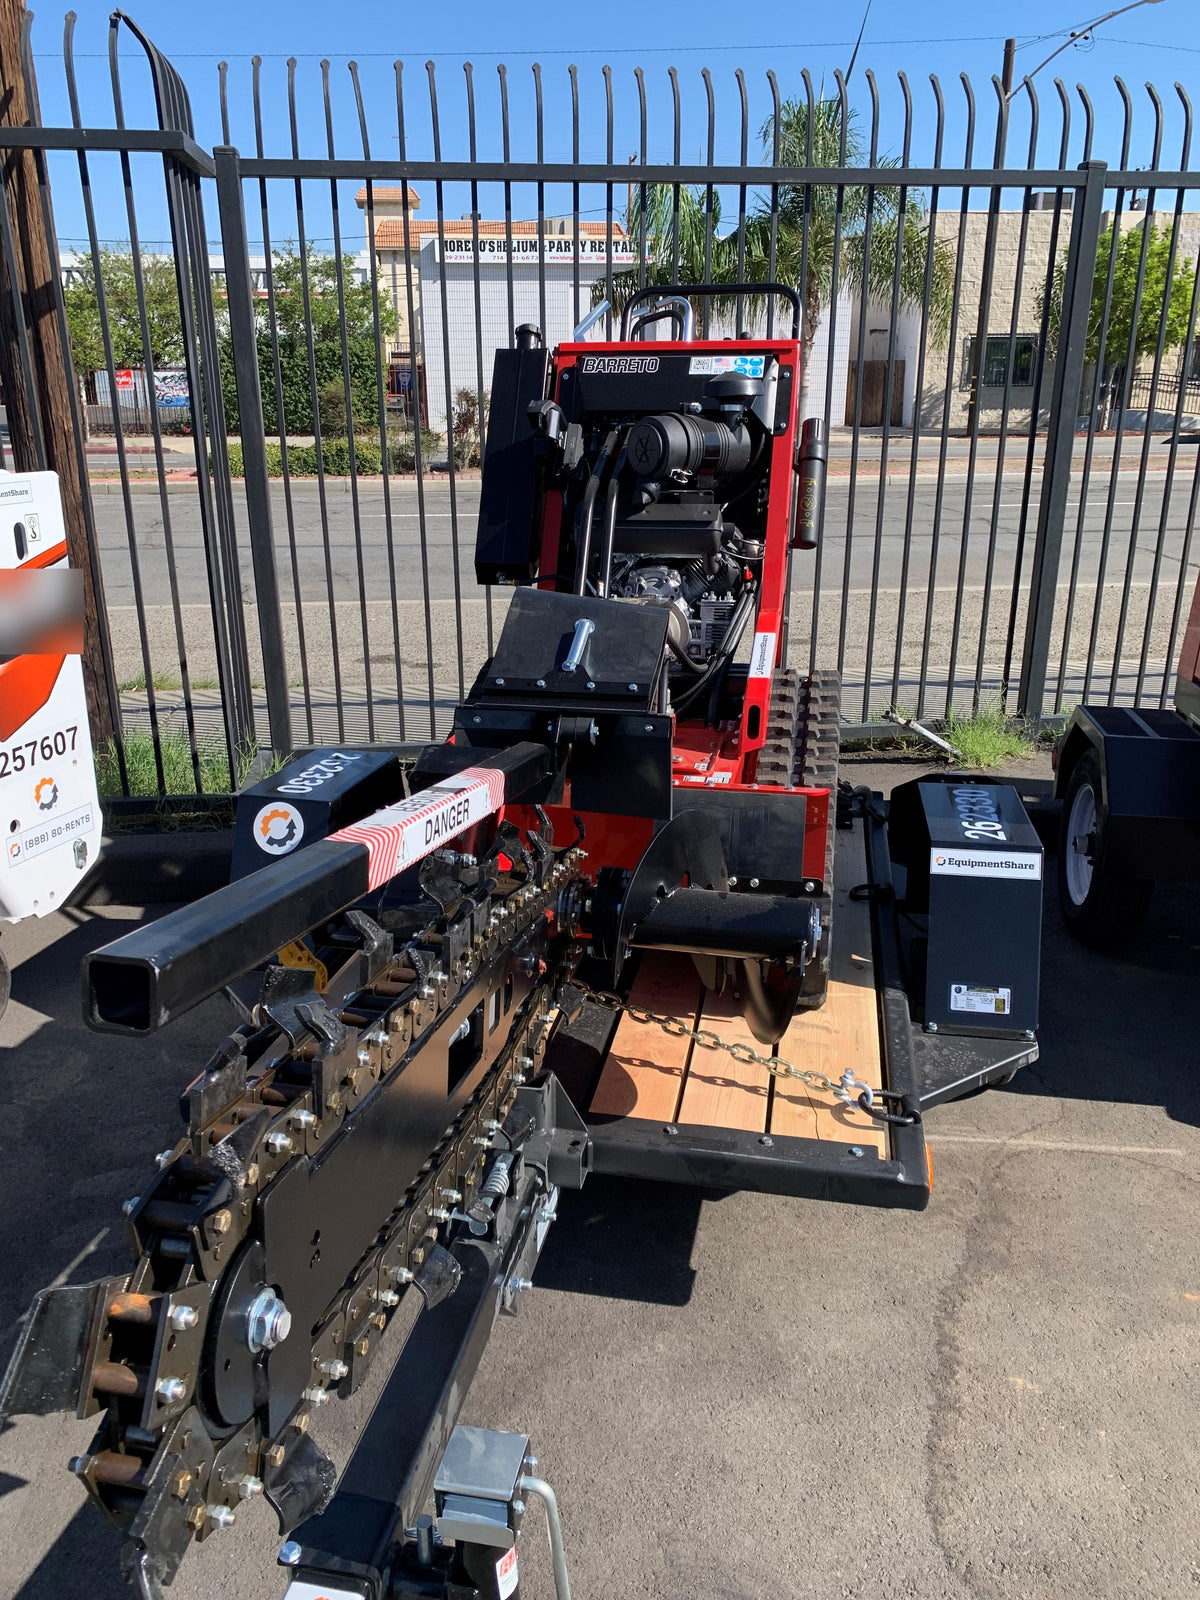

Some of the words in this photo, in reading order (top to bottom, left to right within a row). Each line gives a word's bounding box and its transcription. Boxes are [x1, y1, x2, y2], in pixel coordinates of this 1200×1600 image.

[496, 240, 538, 252] HELIUM
[548, 240, 587, 252] PARY
[590, 240, 642, 252] RETALS
[582, 356, 660, 373] BARRETO
[0, 726, 78, 778] 257607
[277, 752, 362, 794] 262330
[25, 832, 49, 850] (888)
[51, 814, 90, 836] 80-RENTS
[425, 798, 470, 845] DANGER
[952, 788, 1007, 840] 262330
[948, 857, 1035, 870] EquipmentShare
